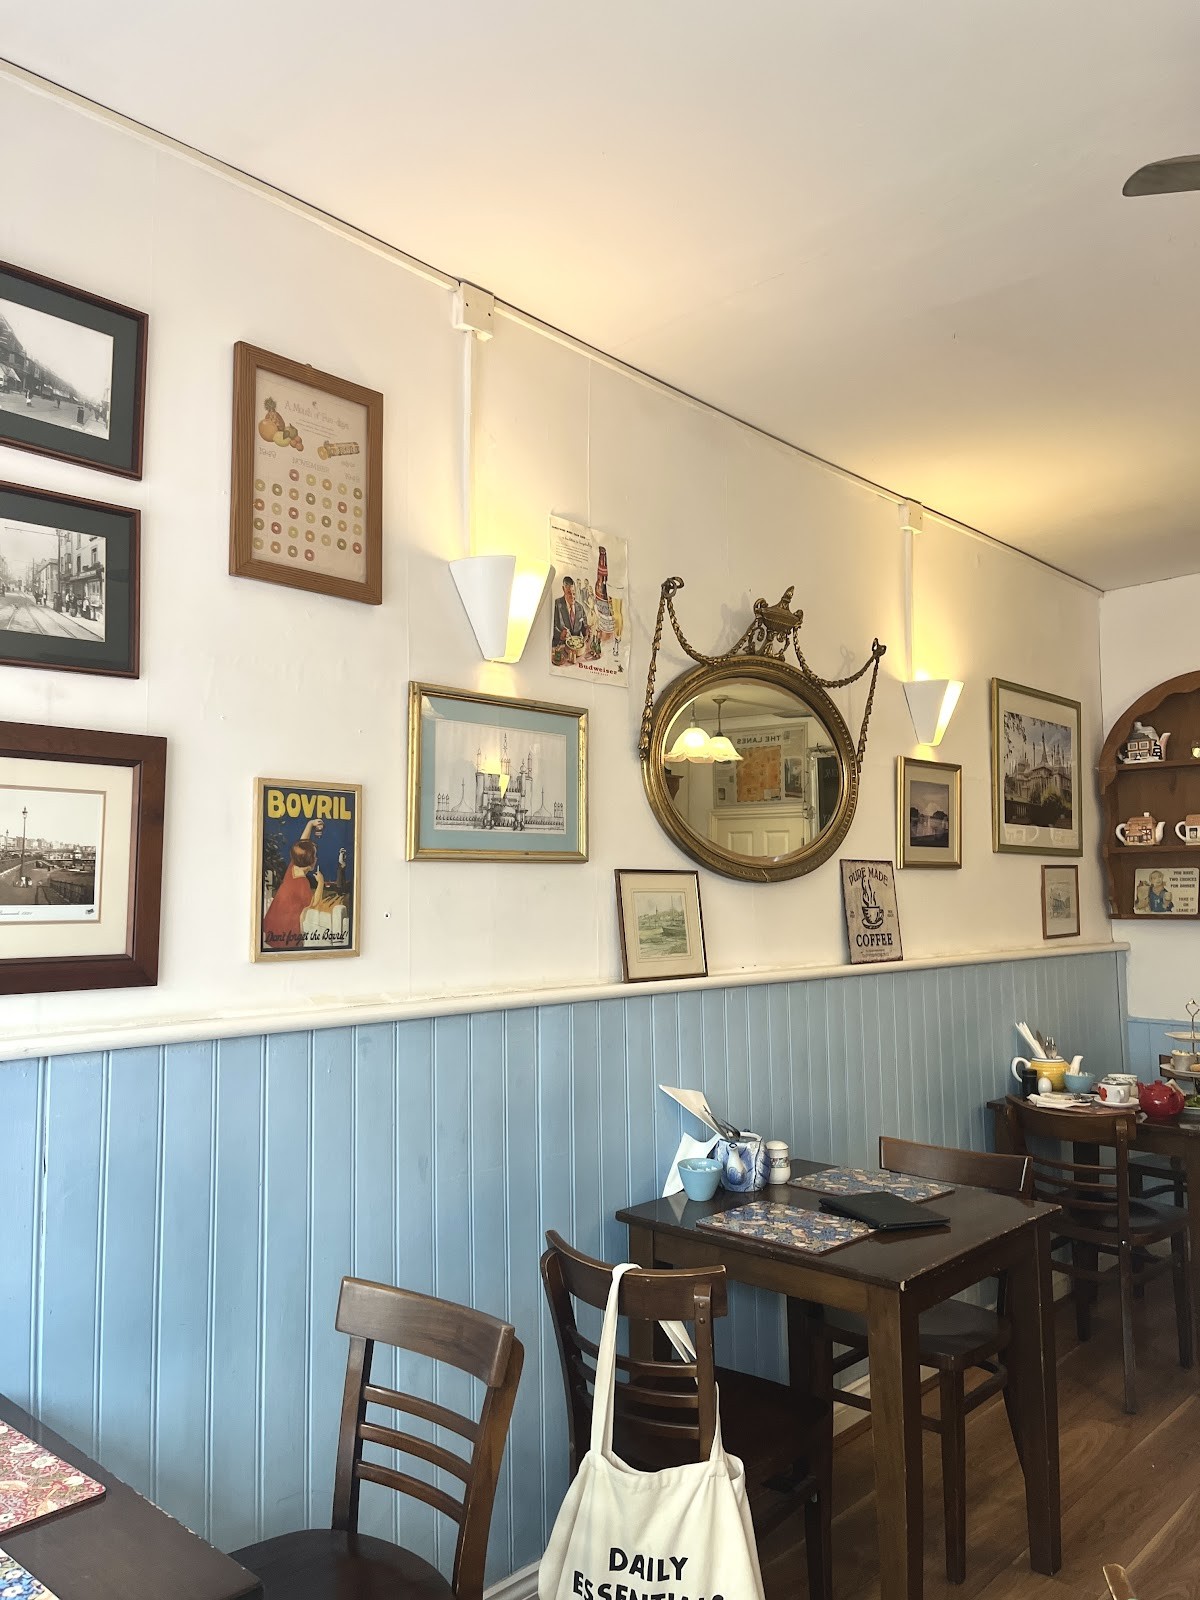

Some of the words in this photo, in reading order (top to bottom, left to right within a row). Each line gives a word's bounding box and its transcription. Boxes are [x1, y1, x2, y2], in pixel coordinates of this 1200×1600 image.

[578, 662, 618, 675] Budweiser
[267, 789, 352, 821] BOVRIL
[867, 866, 889, 887] MADE
[310, 929, 321, 941] the
[856, 932, 893, 947] COFFEE
[609, 1547, 689, 1582] DAILY
